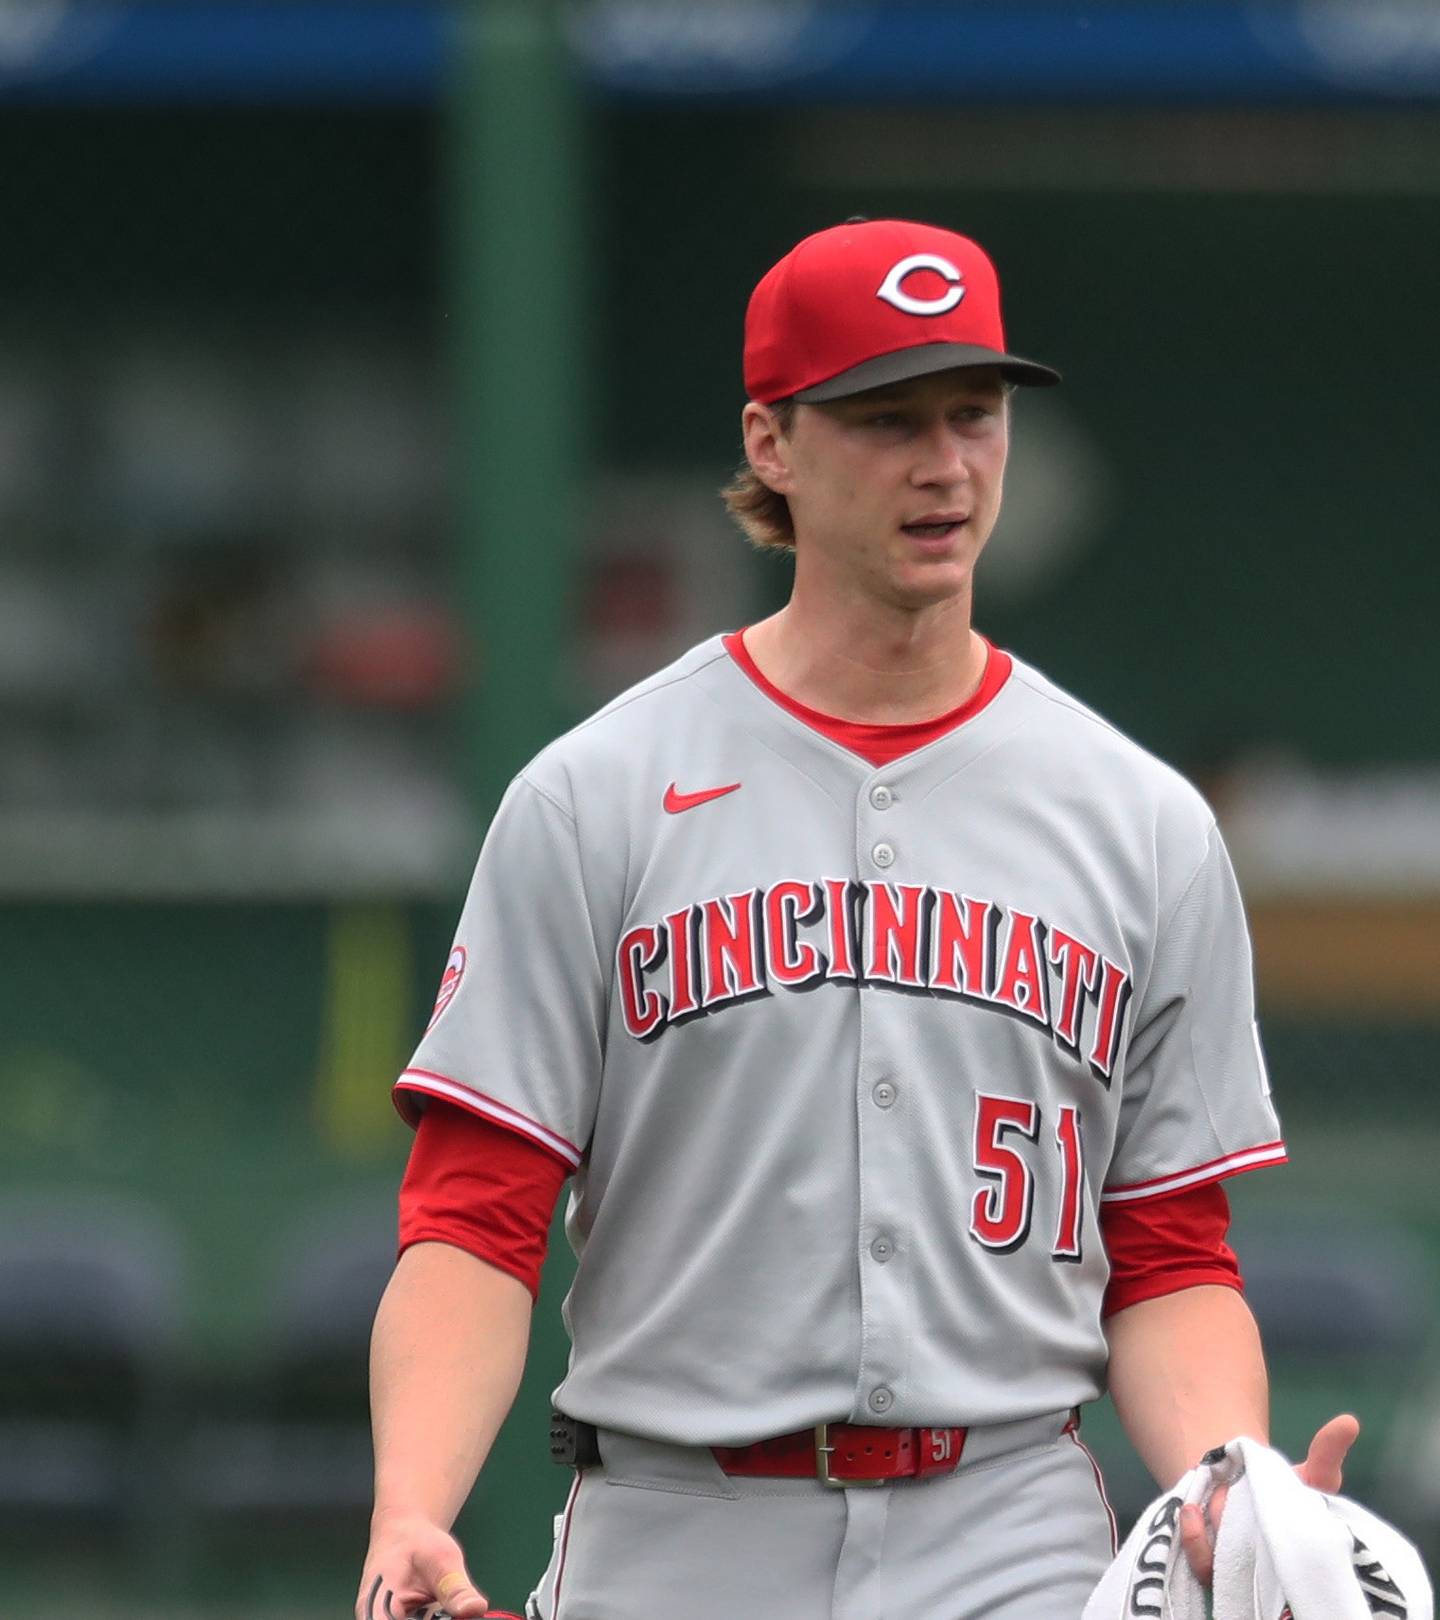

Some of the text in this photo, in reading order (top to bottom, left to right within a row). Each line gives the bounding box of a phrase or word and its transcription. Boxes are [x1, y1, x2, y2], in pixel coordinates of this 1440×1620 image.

[875, 252, 966, 317] C
[616, 877, 1132, 1087] CINCINNATI
[969, 1090, 1084, 1262] 51
[932, 1428, 951, 1461] 51
